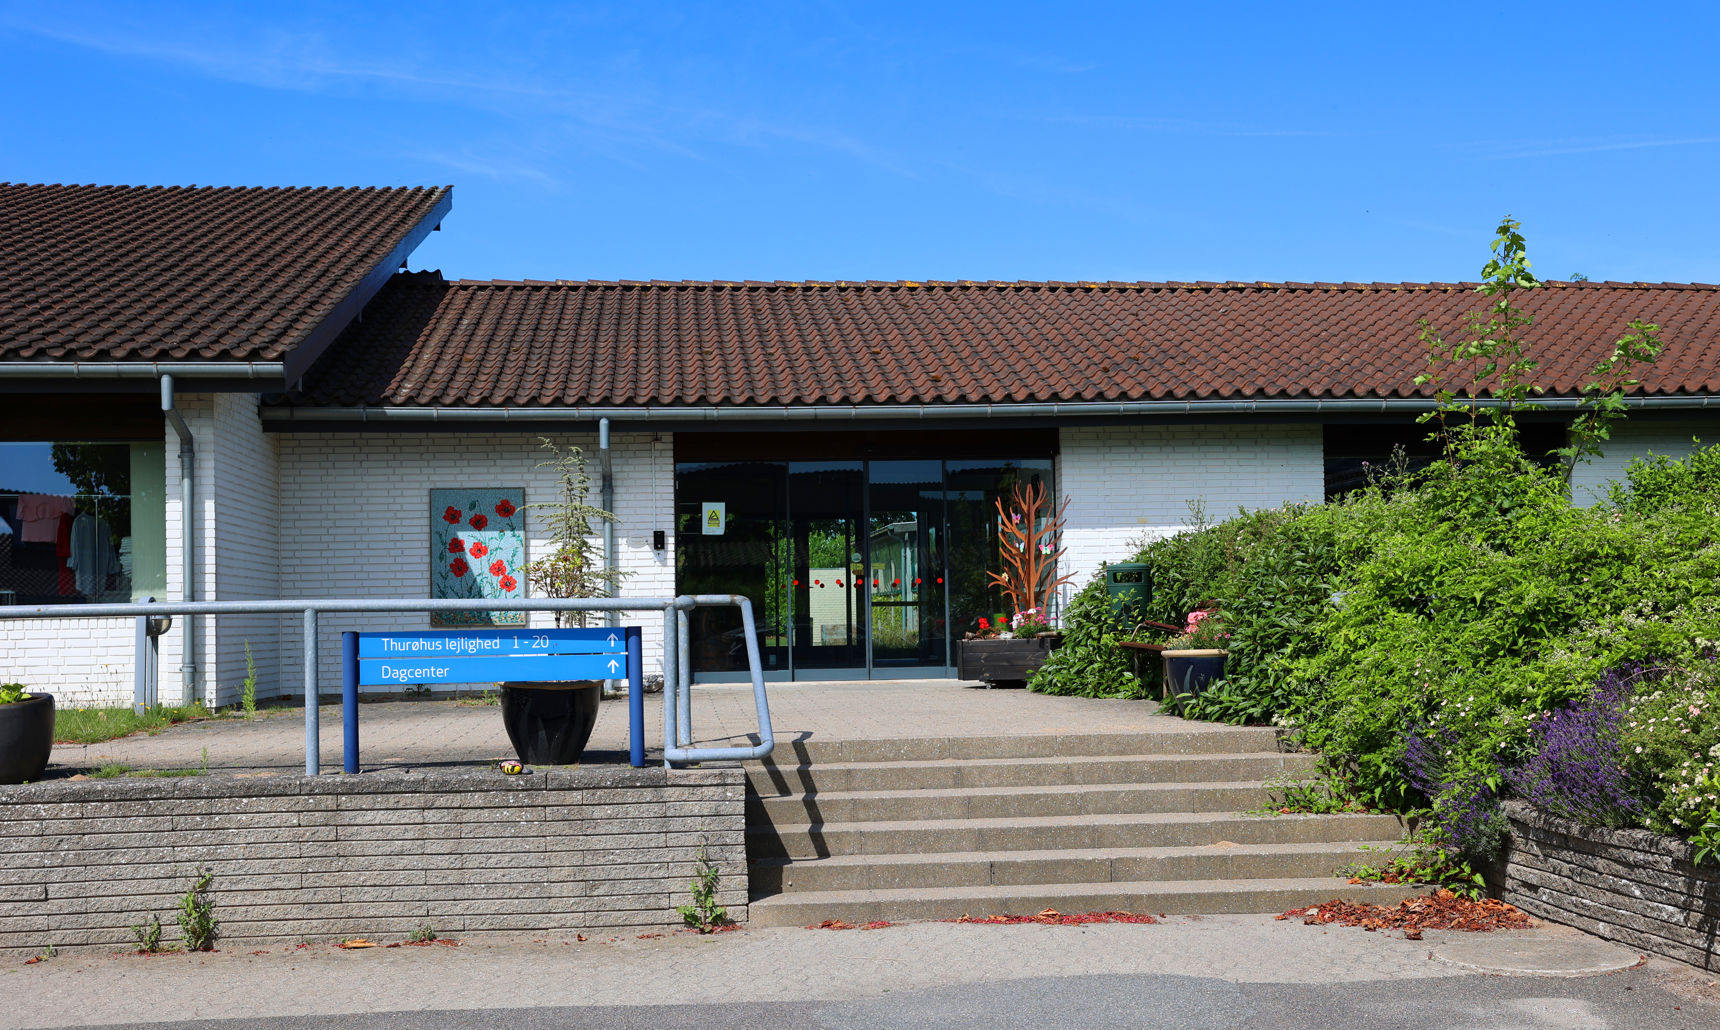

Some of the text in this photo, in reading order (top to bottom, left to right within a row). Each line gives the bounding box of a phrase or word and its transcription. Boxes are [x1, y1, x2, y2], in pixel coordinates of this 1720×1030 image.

[381, 638, 442, 652] Thurøhus
[445, 635, 500, 653] lejlighed
[512, 636, 520, 648] 1
[532, 635, 549, 648] 20
[381, 666, 449, 681] Dagcenter
